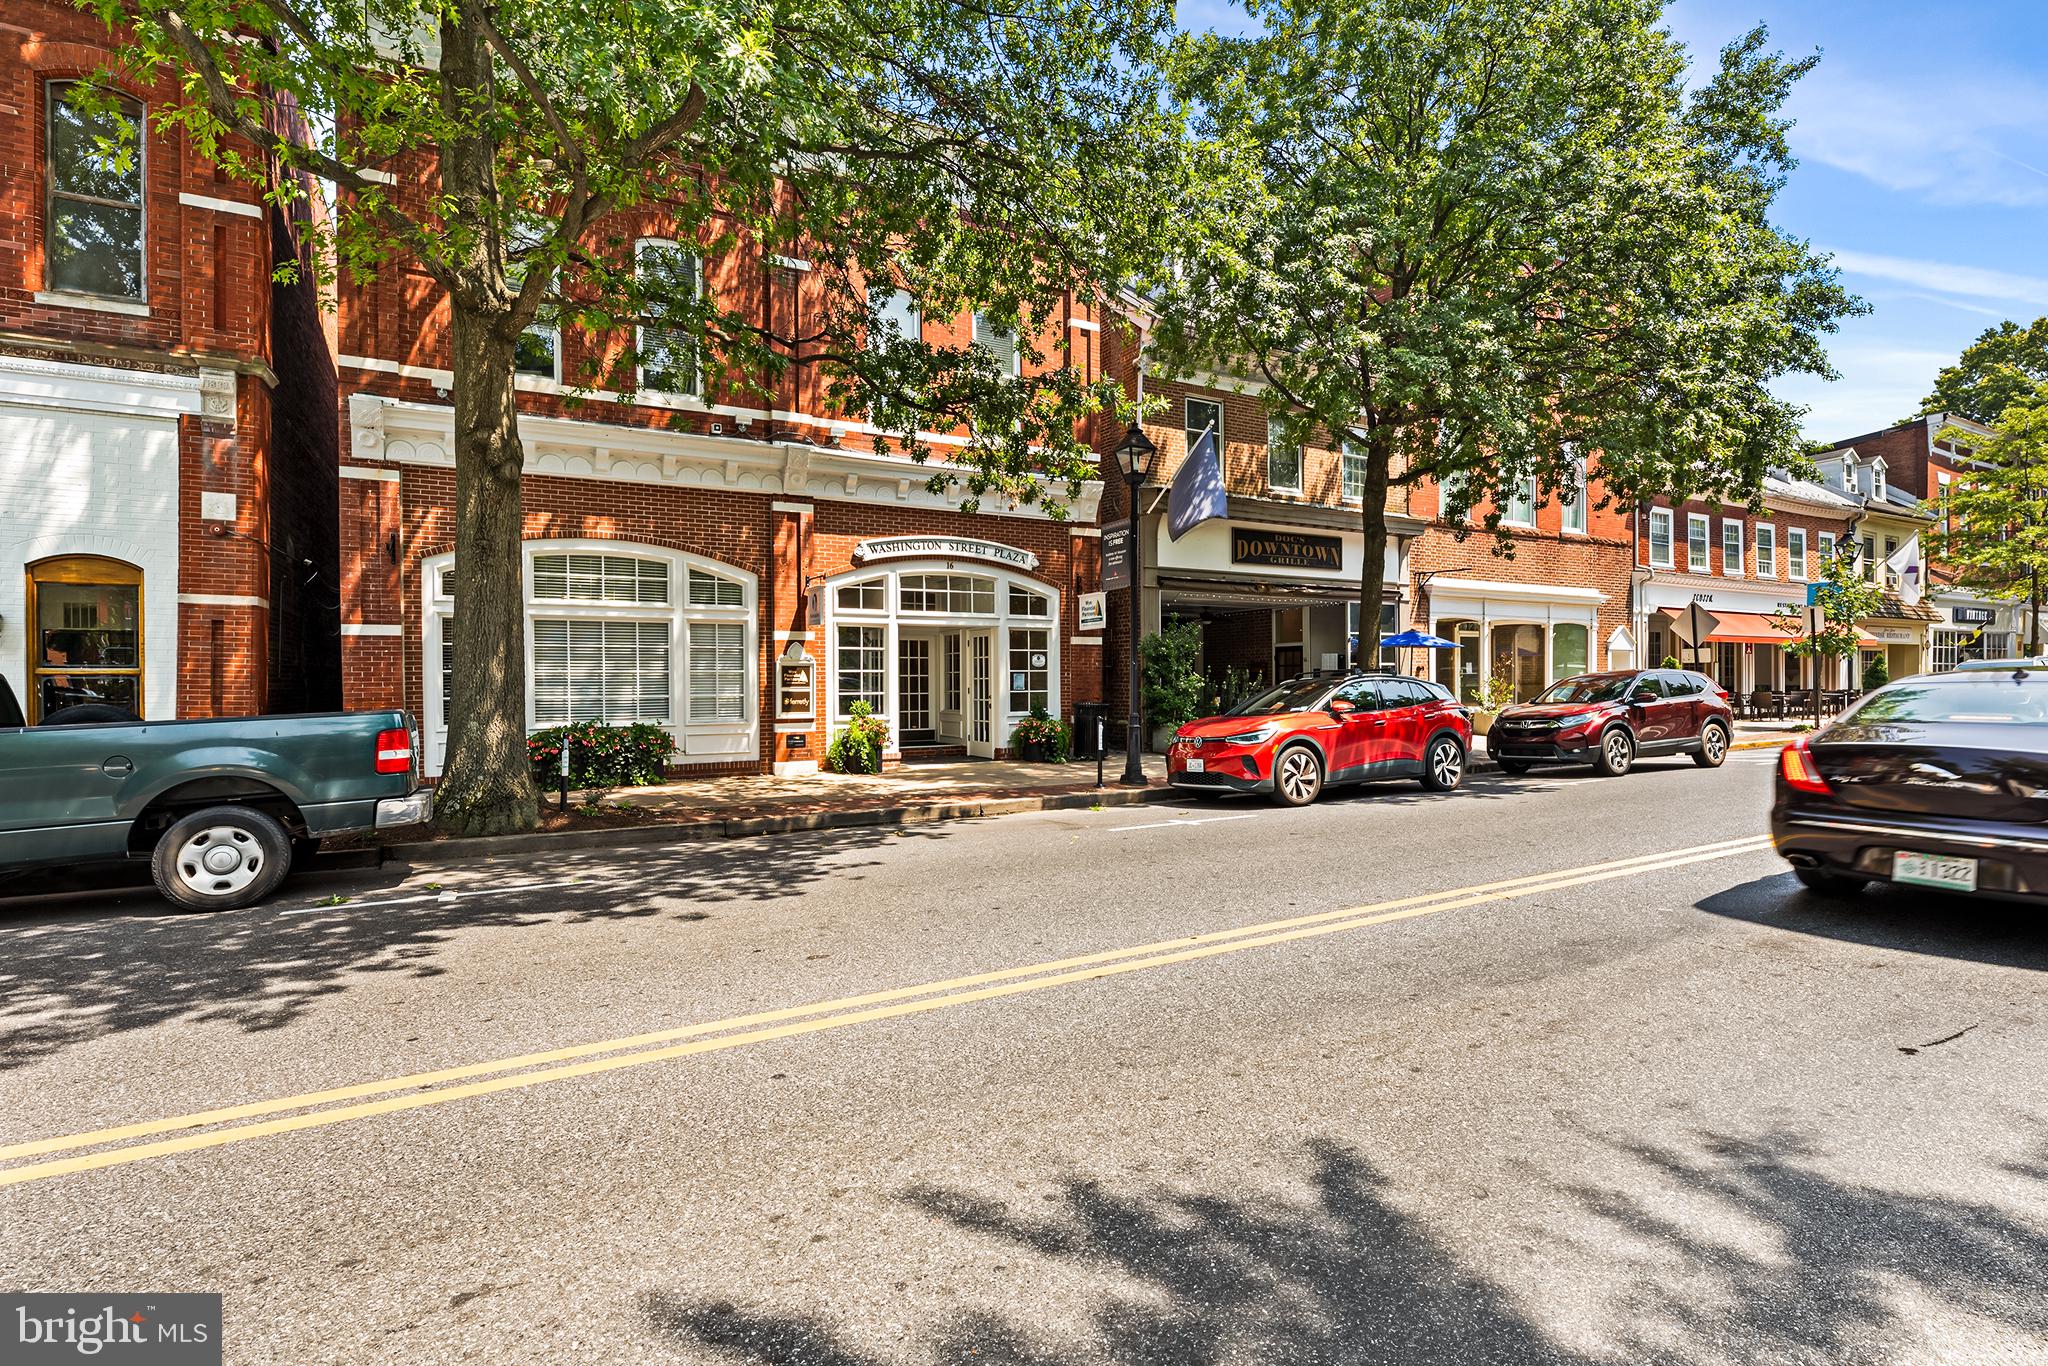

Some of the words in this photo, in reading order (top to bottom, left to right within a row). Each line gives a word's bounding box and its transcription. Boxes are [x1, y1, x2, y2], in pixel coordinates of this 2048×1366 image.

[1103, 529, 1130, 541] INSPIRATION
[1275, 534, 1305, 543] DOC'S
[868, 541, 942, 555] WASHINGTON
[949, 542, 988, 555] STREET
[993, 548, 1026, 565] PLAZA
[1236, 539, 1340, 567] DOWNTOWN
[946, 562, 954, 570] 16
[1270, 556, 1310, 566] GRILLE
